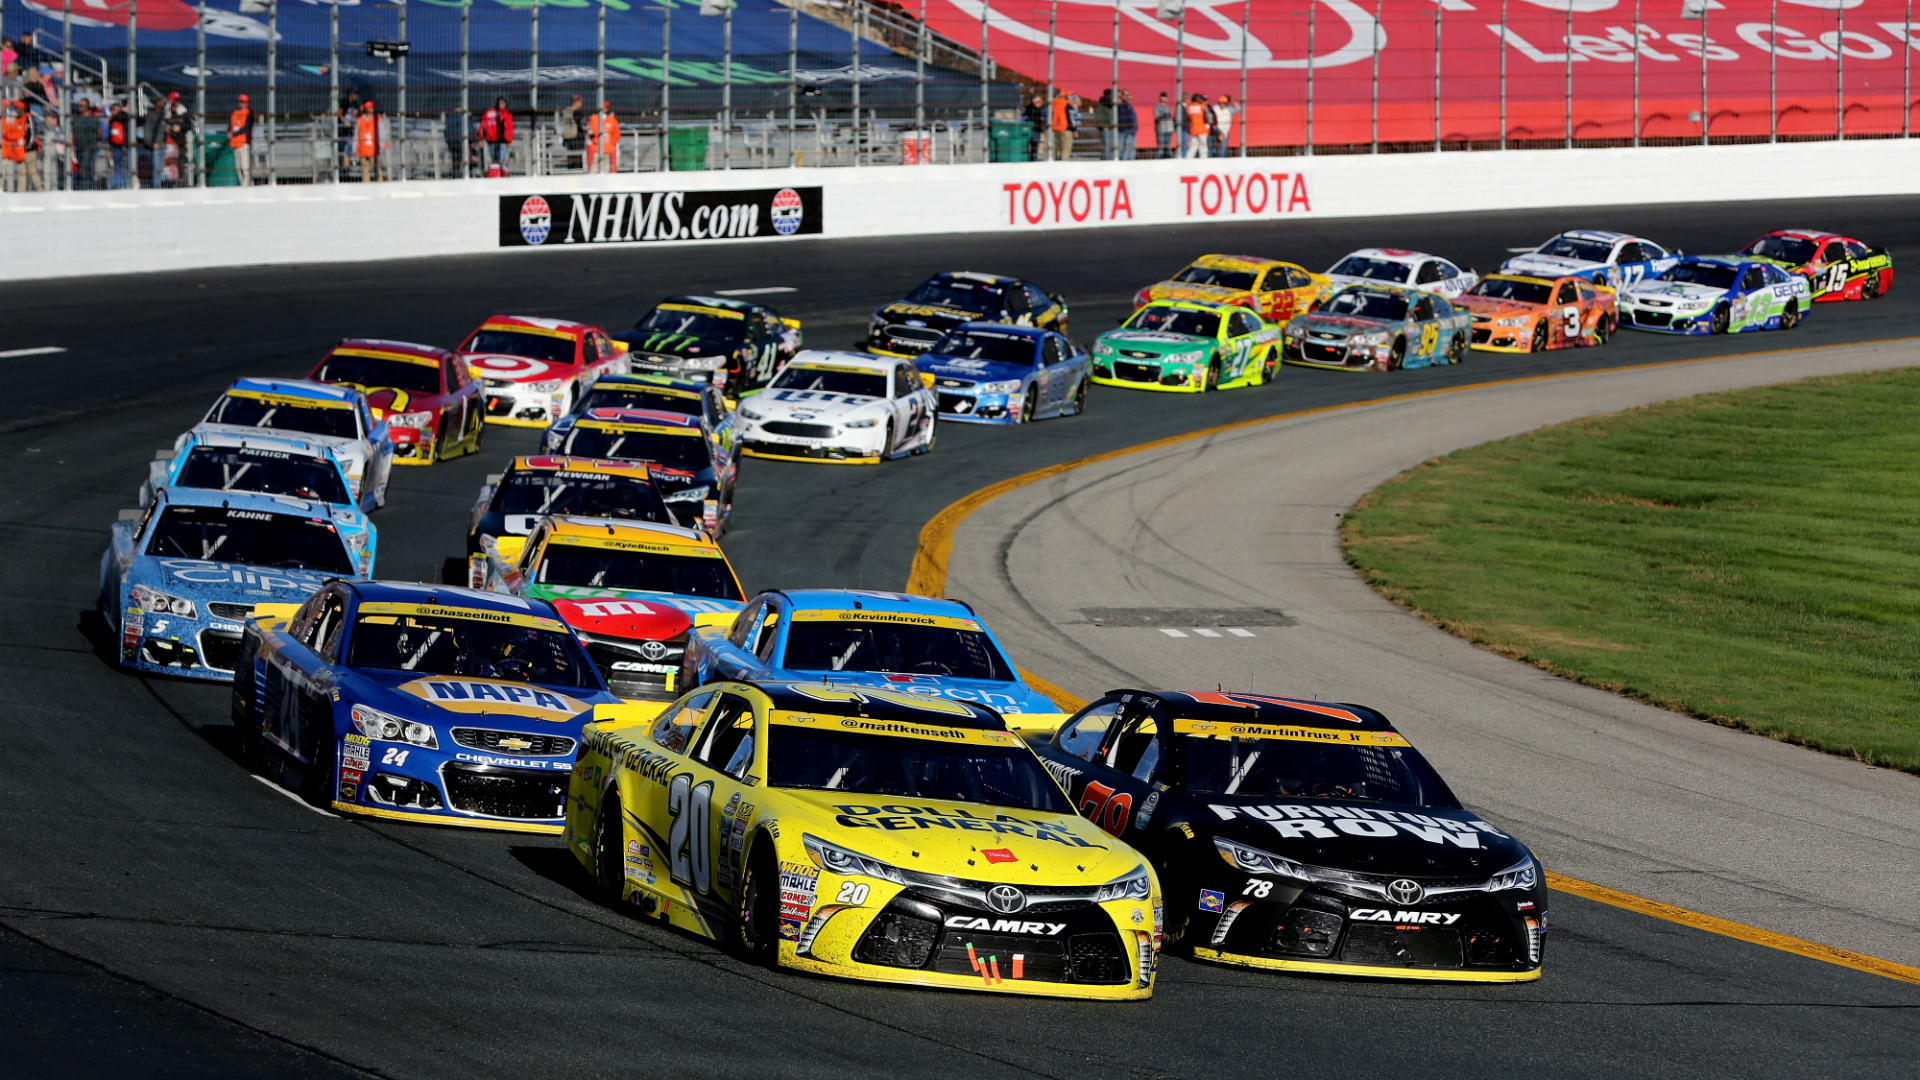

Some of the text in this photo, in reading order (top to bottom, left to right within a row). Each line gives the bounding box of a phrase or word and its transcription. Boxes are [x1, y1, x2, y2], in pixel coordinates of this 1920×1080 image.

[1485, 22, 1740, 62] Let's
[1735, 22, 1893, 60] Go
[1003, 179, 1133, 225] TOYOTA
[1180, 172, 1311, 216] TOYOTA
[564, 191, 759, 243] NHMS.com
[1621, 264, 1645, 290] 17
[1773, 281, 1806, 297] GEICO
[1826, 263, 1849, 293] 15
[1270, 291, 1294, 320] 22
[1747, 294, 1772, 323] 13
[1562, 305, 1581, 338] 3
[1418, 322, 1440, 357] 95
[757, 342, 777, 381] 41
[1230, 338, 1251, 378] 27
[457, 395, 468, 442] 1
[239, 448, 291, 460] PATRICK
[554, 470, 611, 482] NEWMAN
[226, 510, 273, 522] KAHNE
[604, 540, 670, 553] @KyleBusch
[173, 569, 323, 595] Clips
[416, 606, 512, 623] @chaseelliott
[573, 601, 656, 617] m
[838, 611, 937, 626] @KevinHarvick
[150, 619, 170, 634] 5
[610, 660, 682, 675] CAMR
[427, 681, 570, 712] NAPA
[343, 733, 373, 746] MOOG
[841, 718, 967, 741] @mattkenseth
[344, 744, 370, 758] MAHLE
[381, 747, 410, 767] 24
[455, 752, 573, 770] CHEVROLET SS
[625, 748, 680, 788] GENERAL
[831, 804, 1077, 836] DOLLAR
[1208, 804, 1510, 840] FURNITURE
[668, 773, 714, 895] 20
[835, 814, 1109, 851] GENERAL
[1265, 819, 1482, 850] ROW
[781, 861, 819, 878] MOOG
[781, 876, 817, 892] MAHLE
[835, 881, 870, 906] 20
[1242, 878, 1274, 898] 78
[781, 891, 807, 902] COMP
[779, 904, 809, 919] Edelbrock
[1349, 908, 1462, 925] CAMRY
[944, 916, 1067, 936] CAMRY
